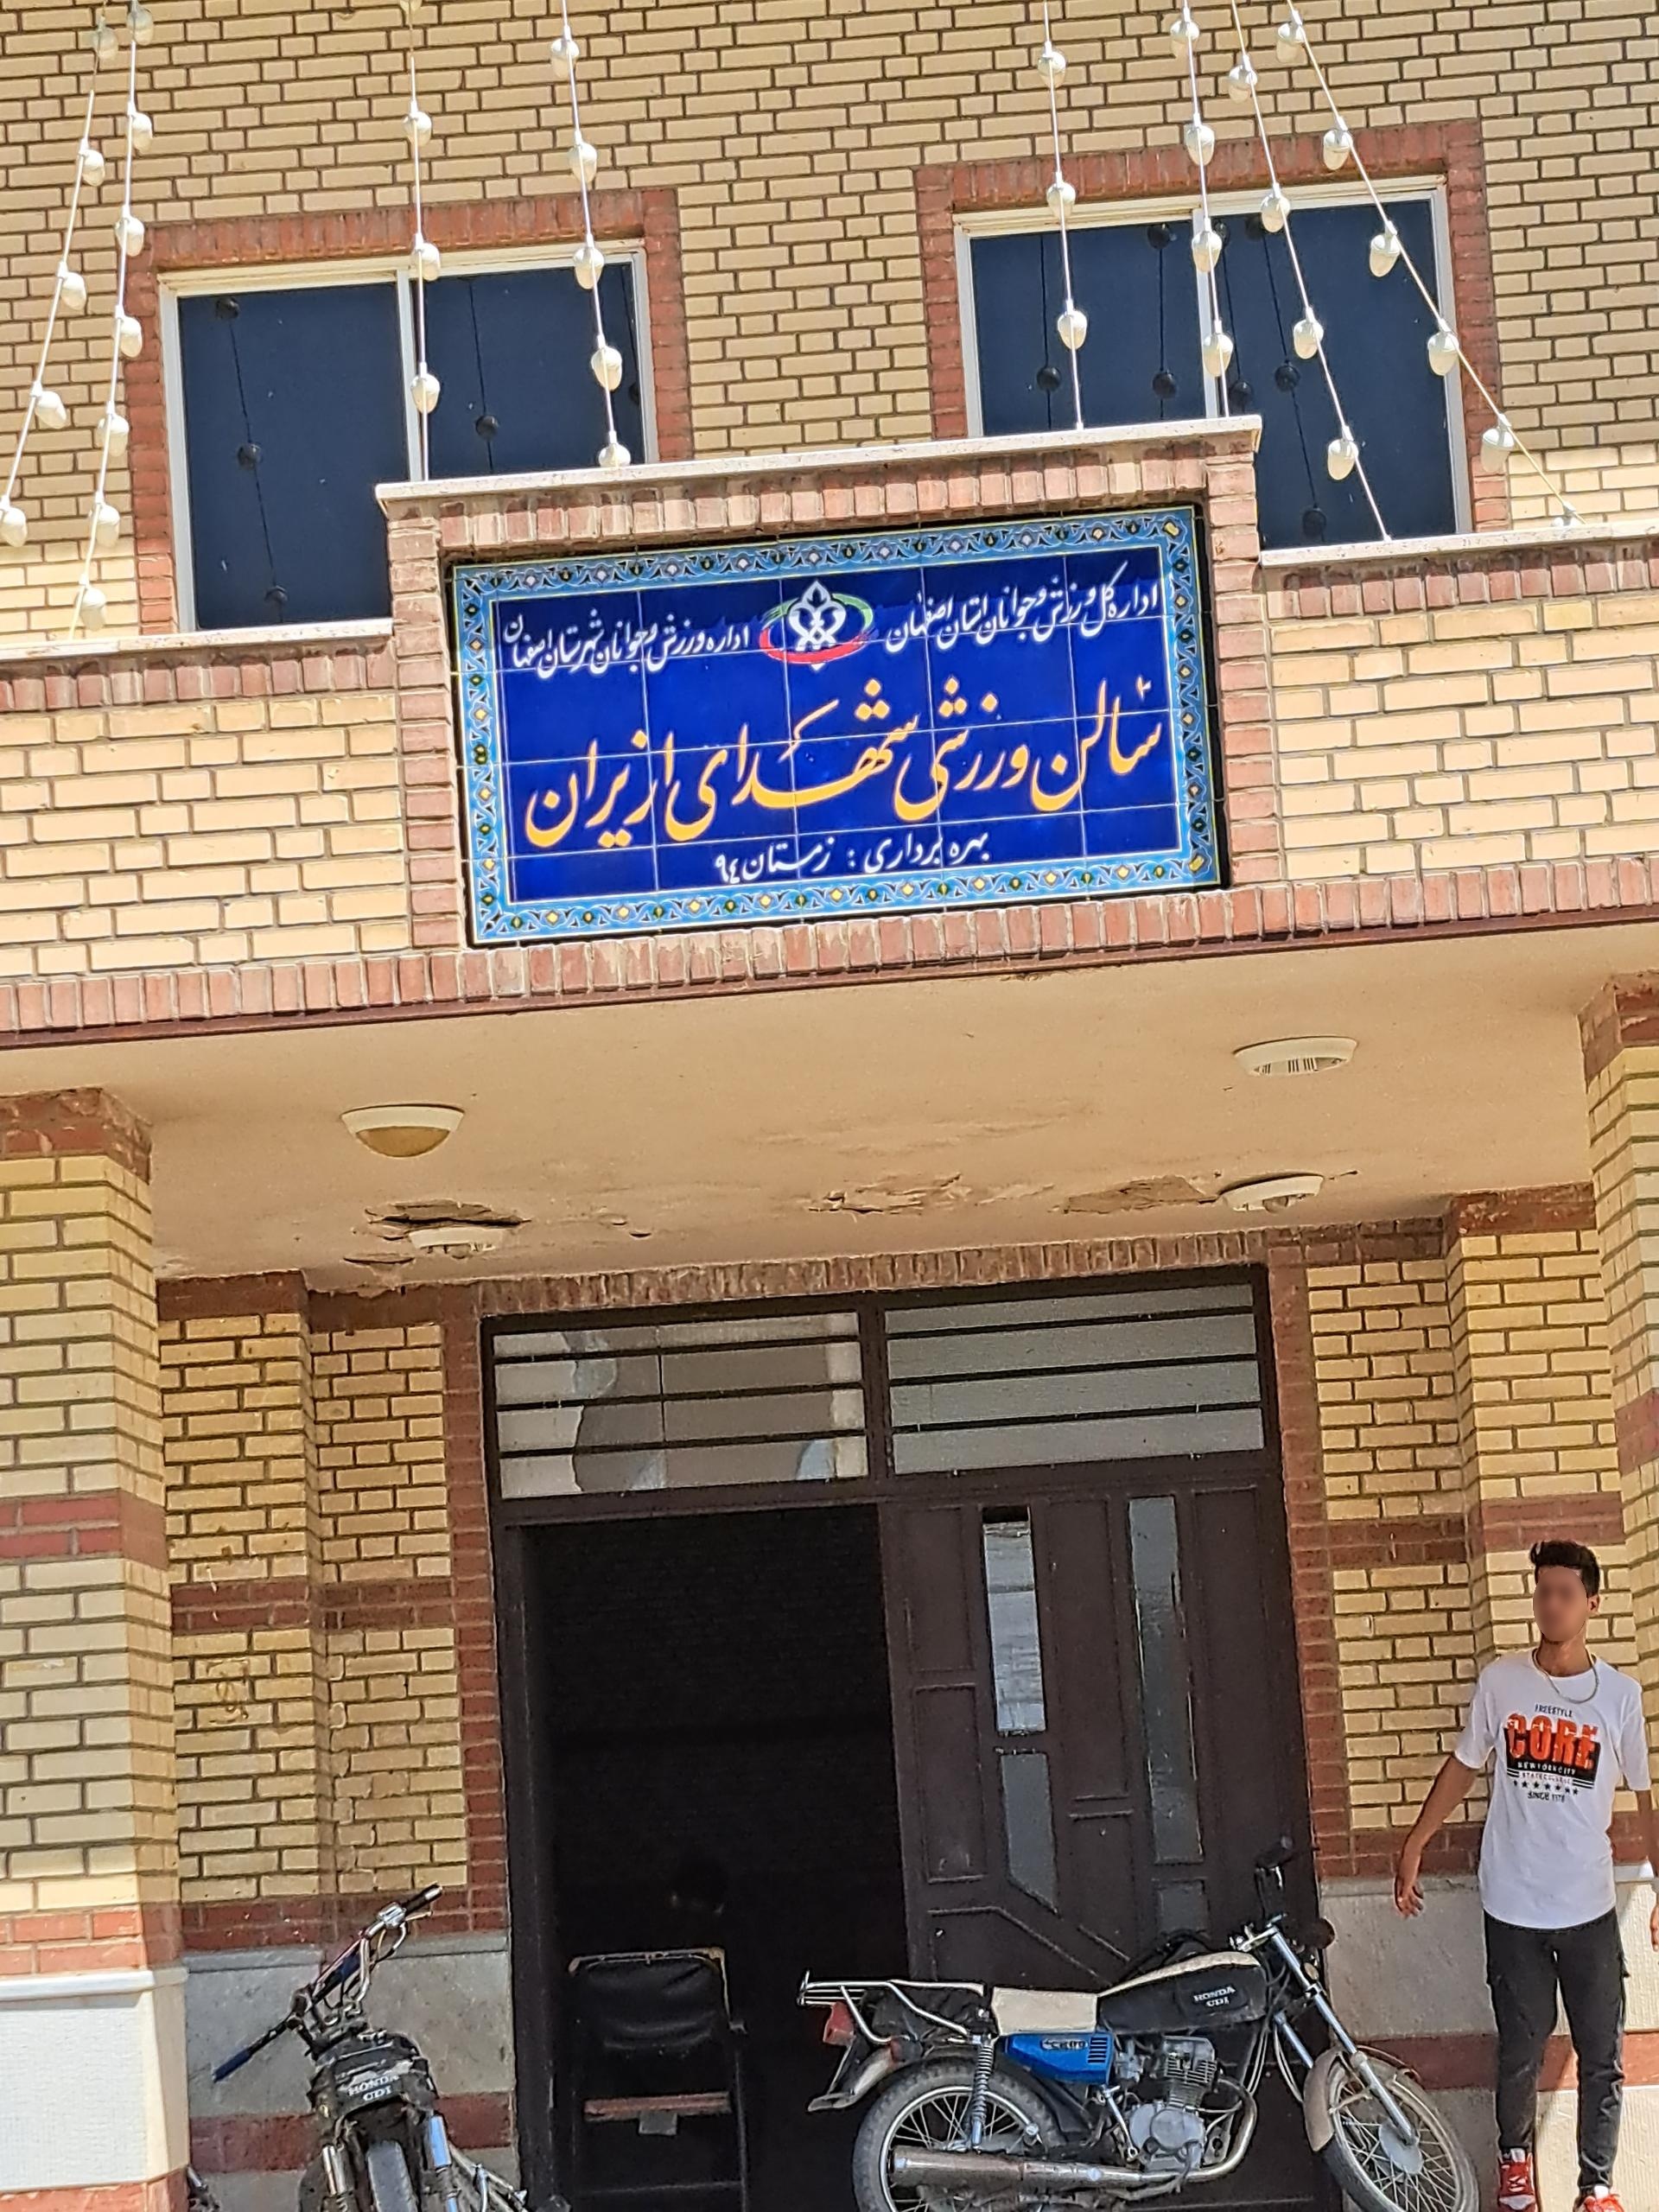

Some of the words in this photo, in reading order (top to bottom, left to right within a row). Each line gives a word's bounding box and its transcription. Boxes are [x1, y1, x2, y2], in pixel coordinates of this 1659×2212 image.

[886, 591, 952, 652] اصفهان
[937, 594, 988, 650] استان
[976, 587, 1033, 645] جوانان
[1033, 575, 1095, 641] ورزش
[1080, 562, 1128, 638] کل
[1109, 583, 1159, 619] اداره
[504, 613, 553, 669] اصفهان
[537, 607, 604, 679] شهرستان
[591, 621, 647, 674] جوانان
[645, 613, 705, 671] ورزش
[706, 626, 749, 652] اداره
[665, 678, 919, 842] شهدای
[893, 675, 1030, 822] ورزشی
[1031, 677, 1161, 811] سالن
[524, 729, 674, 849] ازیران
[743, 837, 835, 880] زمستان
[864, 832, 944, 874] برداری
[949, 832, 989, 863] بهره
[1535, 1703, 1573, 1717] FREESTYLE
[1506, 1713, 1598, 1770] CORE
[1528, 1791, 1549, 1801] SINCE
[1192, 1986, 1236, 2002] HONDA
[1205, 1996, 1230, 2007] CDI
[347, 2075, 399, 2096] HONDA
[363, 2085, 392, 2101] CDI
